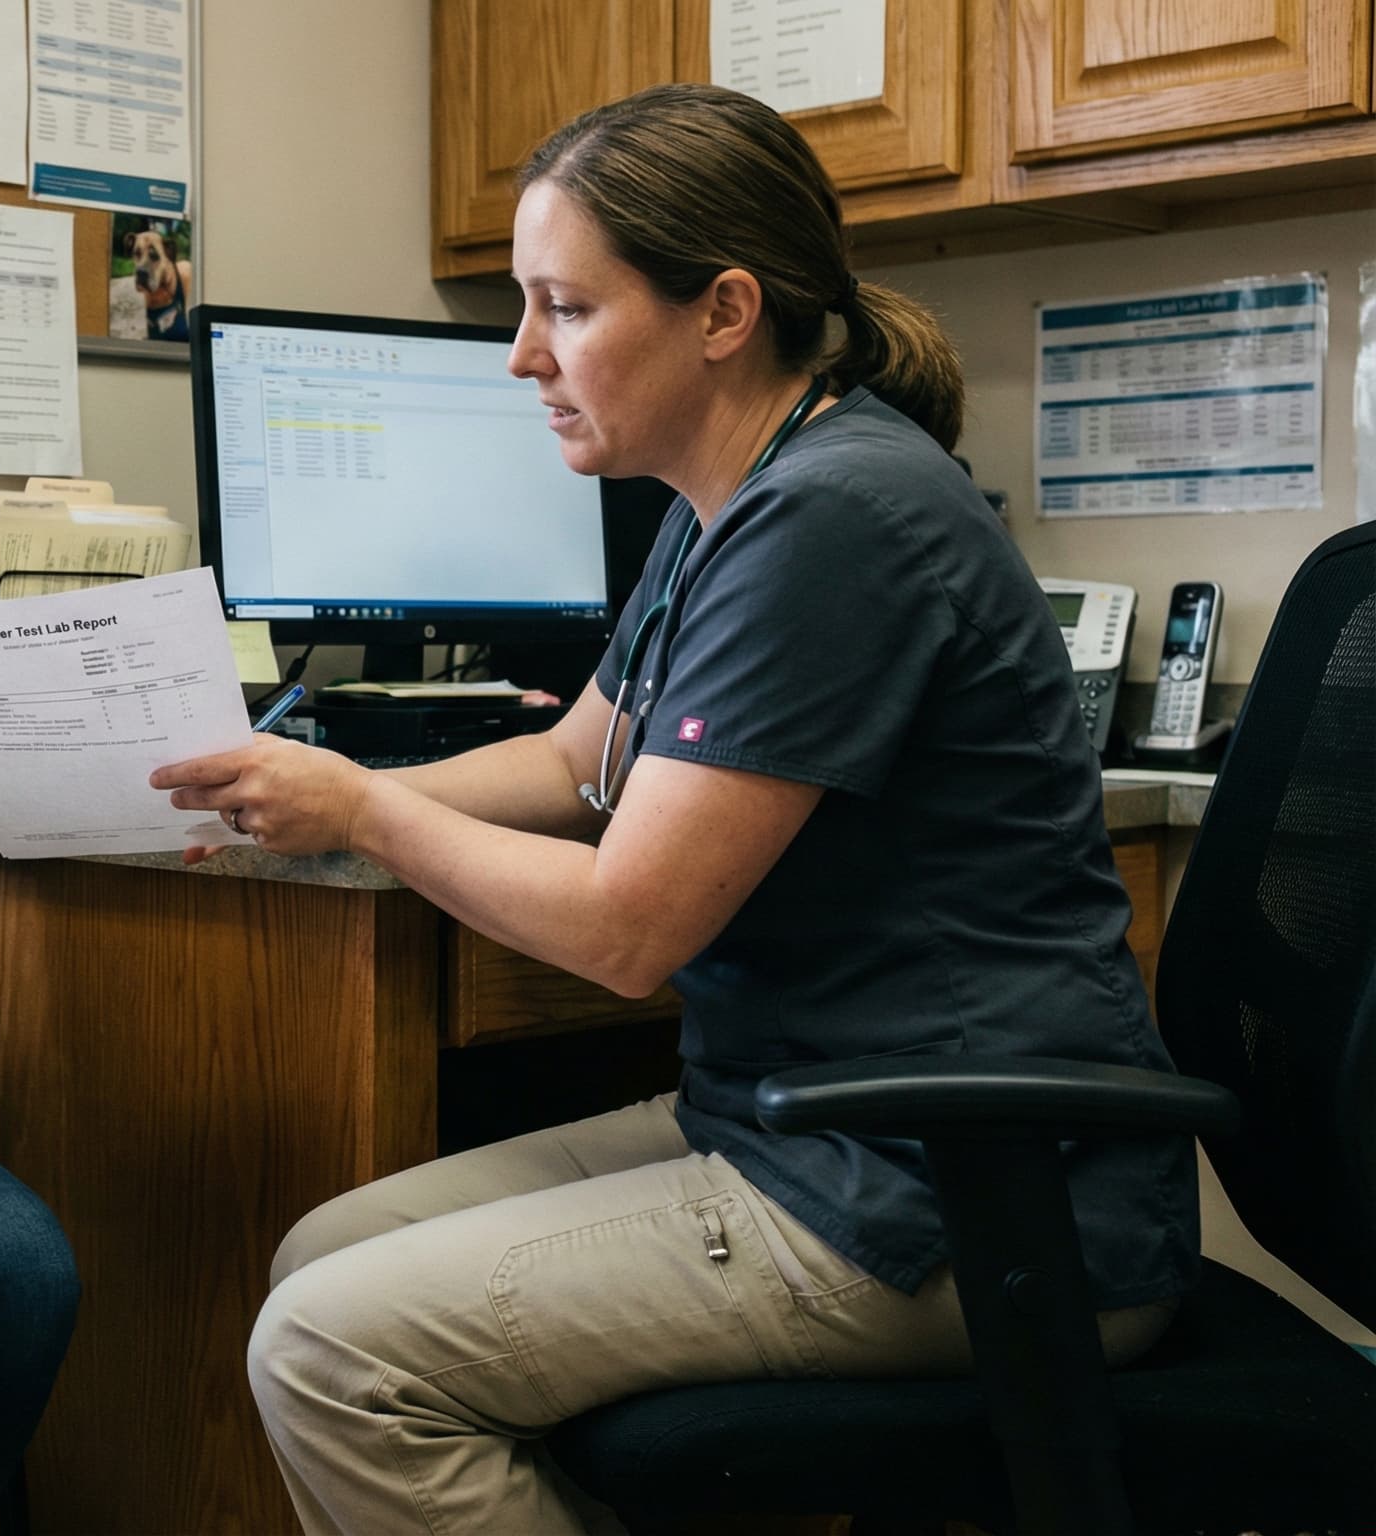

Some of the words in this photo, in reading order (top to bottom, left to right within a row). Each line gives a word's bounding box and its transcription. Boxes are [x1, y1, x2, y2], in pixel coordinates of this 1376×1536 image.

[15, 625, 43, 638] Test
[45, 622, 70, 635] Lab
[73, 615, 118, 631] Report
